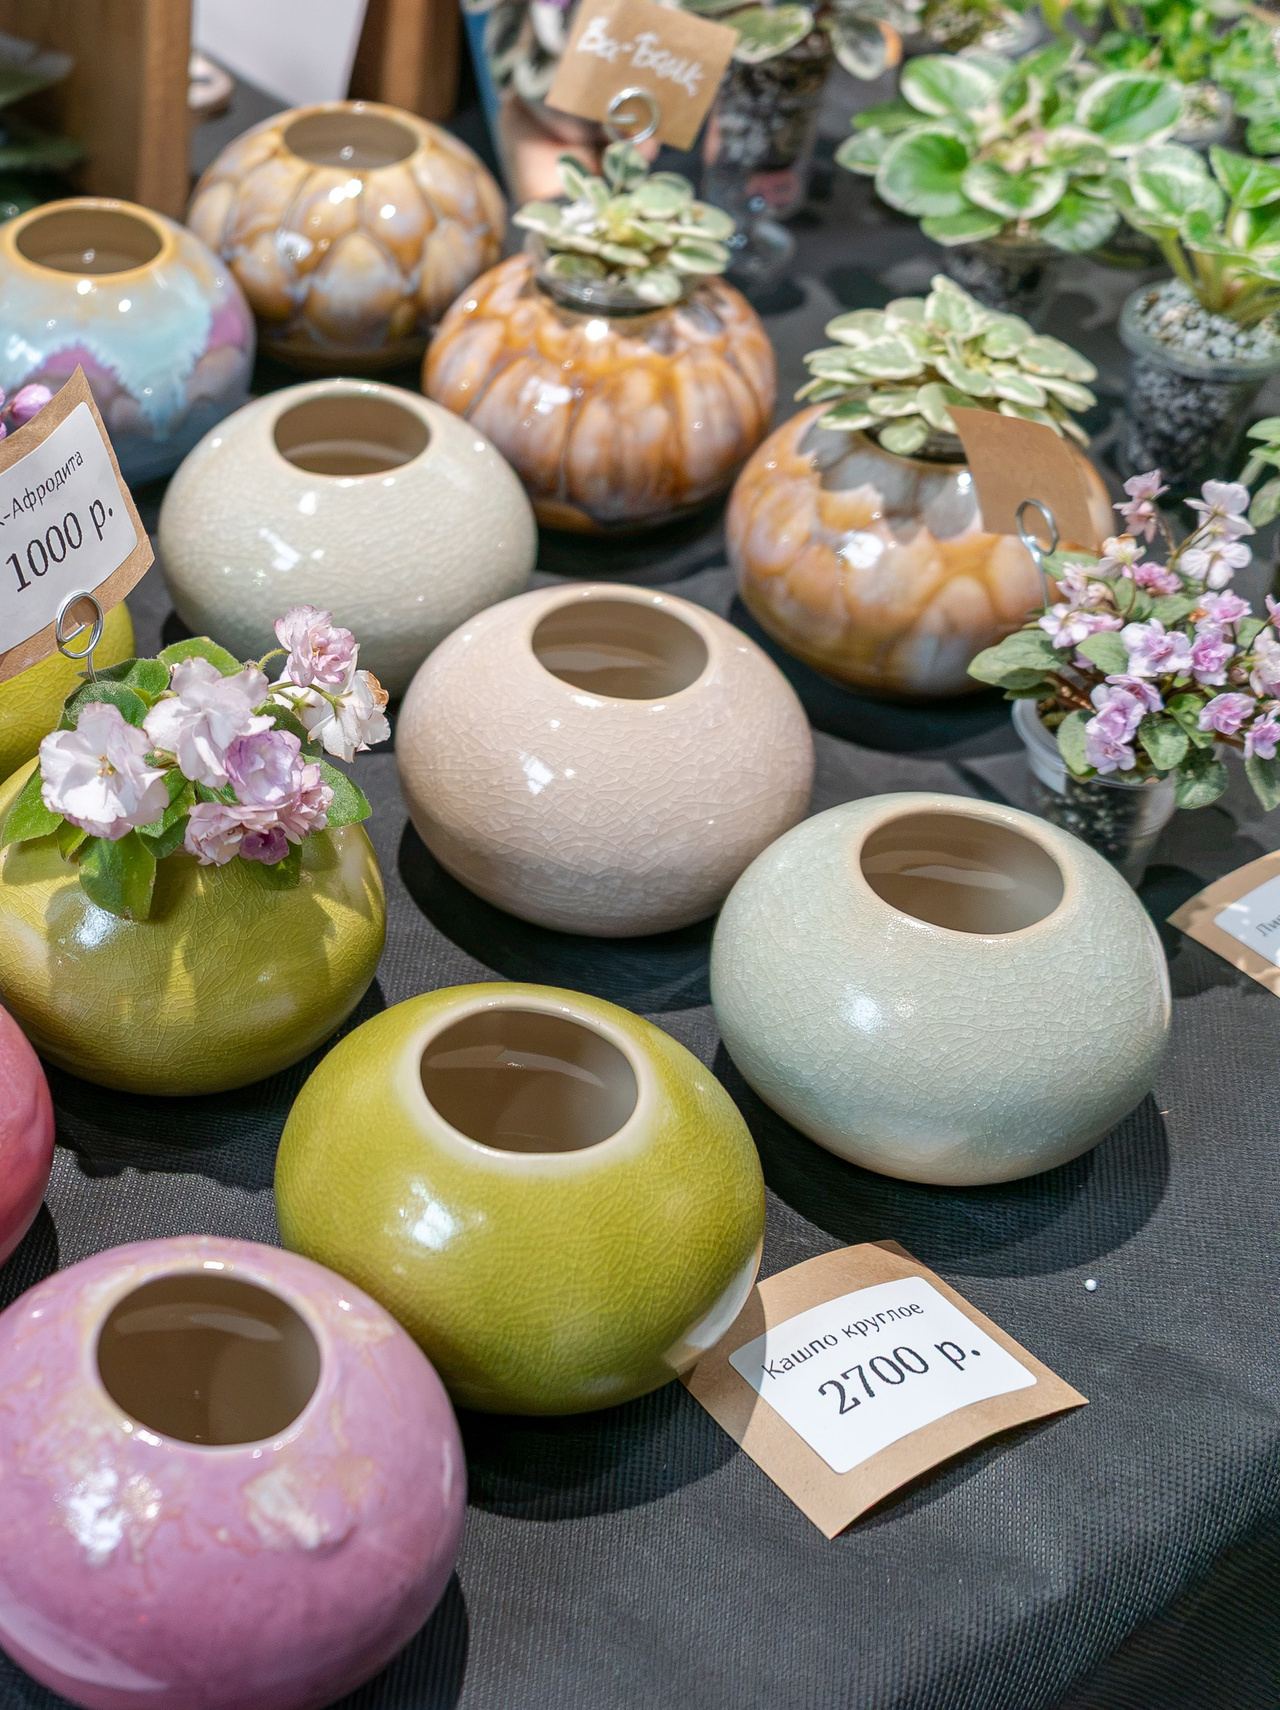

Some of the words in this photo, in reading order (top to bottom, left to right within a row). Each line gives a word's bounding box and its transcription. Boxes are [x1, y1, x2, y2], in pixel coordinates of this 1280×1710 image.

[5, 512, 83, 593] 1000
[88, 499, 114, 541] р.
[761, 1331, 838, 1380] Кашпо
[842, 1301, 925, 1338] круглое
[817, 1346, 930, 1415] 2700
[933, 1340, 982, 1371] р.
